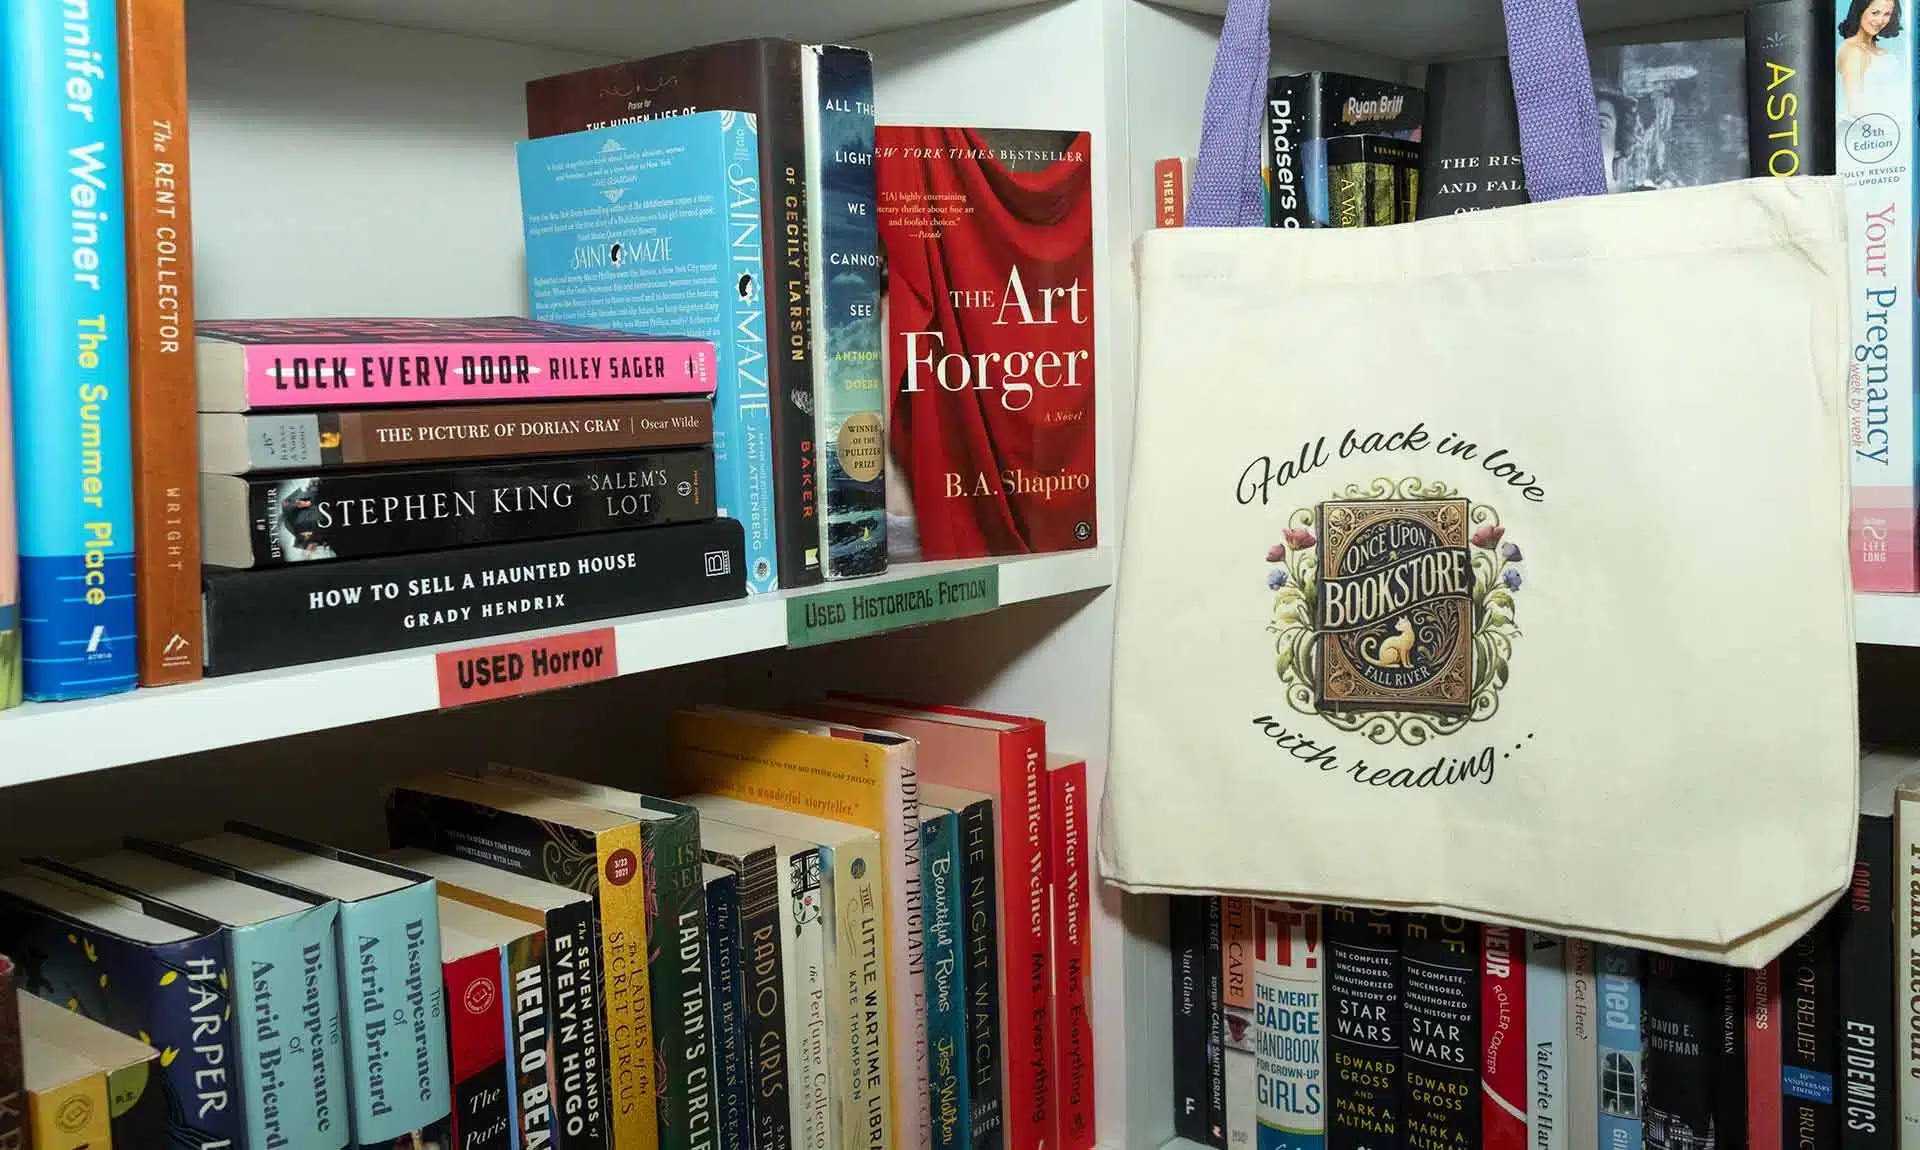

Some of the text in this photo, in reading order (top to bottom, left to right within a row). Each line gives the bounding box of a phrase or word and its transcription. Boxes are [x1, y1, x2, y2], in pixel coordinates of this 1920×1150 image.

[826, 98, 877, 116] ALL THE
[1347, 96, 1379, 118] Ryan
[1853, 139, 1893, 151] Edition
[1861, 123, 1885, 137] 8th
[835, 151, 872, 167] LIGHT
[903, 147, 1084, 162] YORK TIMES BESTSELLER
[1270, 100, 1298, 210] Phasers
[1440, 156, 1480, 169] THE
[847, 202, 867, 216] WE
[899, 191, 922, 203] highly
[927, 204, 948, 214] about
[1438, 182, 1478, 194] AND
[68, 142, 108, 290] Weiner
[728, 163, 761, 262] SAINT
[888, 218, 902, 226] and
[152, 120, 179, 354] The RENT COLLECTOR
[570, 237, 673, 269] SAINT MAZIE
[830, 252, 880, 267] CANNOT
[785, 195, 804, 361] CECILY LARSON
[949, 263, 1088, 325] THE Art
[849, 304, 872, 317] SEE
[1854, 201, 1897, 466] Your Pregnancy
[274, 356, 349, 390] LOCK
[362, 356, 450, 387] EVERY
[462, 354, 531, 385] DOOR
[548, 356, 602, 381] RILEY
[609, 356, 665, 379] SAGER
[735, 310, 769, 420] MAZIE
[899, 331, 1089, 411] Forger
[376, 415, 700, 443] THE PICTURE OF DORIAN GRAY Oscar Wilde
[77, 315, 113, 606] The Summer Place
[800, 440, 814, 518] BAKER
[854, 460, 876, 469] PRIZE
[1236, 422, 1546, 505] Fall back in love
[317, 482, 574, 528] STEPHEN KING
[606, 493, 653, 517] LOT
[943, 468, 1090, 500] B. A. Shapiro
[165, 487, 182, 570] WRIGHT
[267, 487, 281, 559] BESTSELLER
[1347, 525, 1438, 575] ONCE UPON A
[309, 551, 637, 610] HOW TO SELL A HAUNTED HOUSE
[1324, 548, 1470, 628] BOOKSTORE
[403, 593, 568, 630] GRADY HENDRIX
[457, 645, 604, 690] USED Horror
[1363, 665, 1431, 687] FALL RIVER
[1252, 714, 1338, 771] with
[614, 859, 628, 869] 3/23
[1025, 747, 1044, 937] Jennifer Weiner
[1064, 780, 1081, 945] Jennifer Weiner
[615, 867, 629, 879] 2021
[900, 766, 925, 978] ADRIANA TRIGIANI
[966, 809, 992, 1086] THE NIGHT WATCH
[1335, 949, 1347, 959] THE
[678, 909, 706, 1061] LADY TAN'S
[861, 887, 882, 1089] THE LITTLE WARTIME
[930, 851, 959, 1146] Beautiful Ruins Jess Walter
[1256, 983, 1320, 1008] THE MERIT
[1334, 973, 1394, 990] UNAUTHORIZED
[1350, 989, 1397, 1002] HISTORY OF
[1575, 979, 1588, 1001] Get
[358, 935, 393, 1117] Astrid Bricard
[405, 919, 433, 1103] Disappearance
[515, 964, 547, 1075] HELLO
[608, 930, 635, 1115] SECRET CIRCUS
[629, 966, 648, 1049] LADIES
[753, 922, 783, 1099] RADIO GIRLS
[808, 989, 825, 1066] Perfume
[1256, 1001, 1320, 1035] BADGE
[1337, 1017, 1392, 1043] WARS
[1340, 1000, 1388, 1022] STAR
[1487, 984, 1511, 1075] ROLLER COASTER
[1651, 1017, 1694, 1038] DAVID E.
[1797, 966, 1816, 1063] OF BELIEF
[185, 958, 230, 1119] HARPER
[251, 960, 289, 1150] Astrid Bricard
[302, 942, 332, 1134] Disappearance
[555, 933, 584, 1137] EVELYN HUGO
[578, 946, 600, 1123] SEVEN HUSBANDS
[849, 970, 861, 1102] KATE THOMPSON
[1256, 1030, 1320, 1064] HANDBOOK
[1651, 1036, 1700, 1056] HOFFMAN
[1256, 1057, 1320, 1081] FOR GROWN-UP
[1335, 1052, 1396, 1074] EDWARD
[1340, 1068, 1390, 1088] GROSS
[1536, 1041, 1553, 1110] Valerie
[1846, 1020, 1877, 1134] EPIDEMICS
[470, 1087, 501, 1115] The
[1256, 1073, 1321, 1116] GIRLS
[1336, 1098, 1375, 1117] MARK
[466, 1115, 509, 1150] Paris
[1336, 1112, 1395, 1134] ALTMAN
